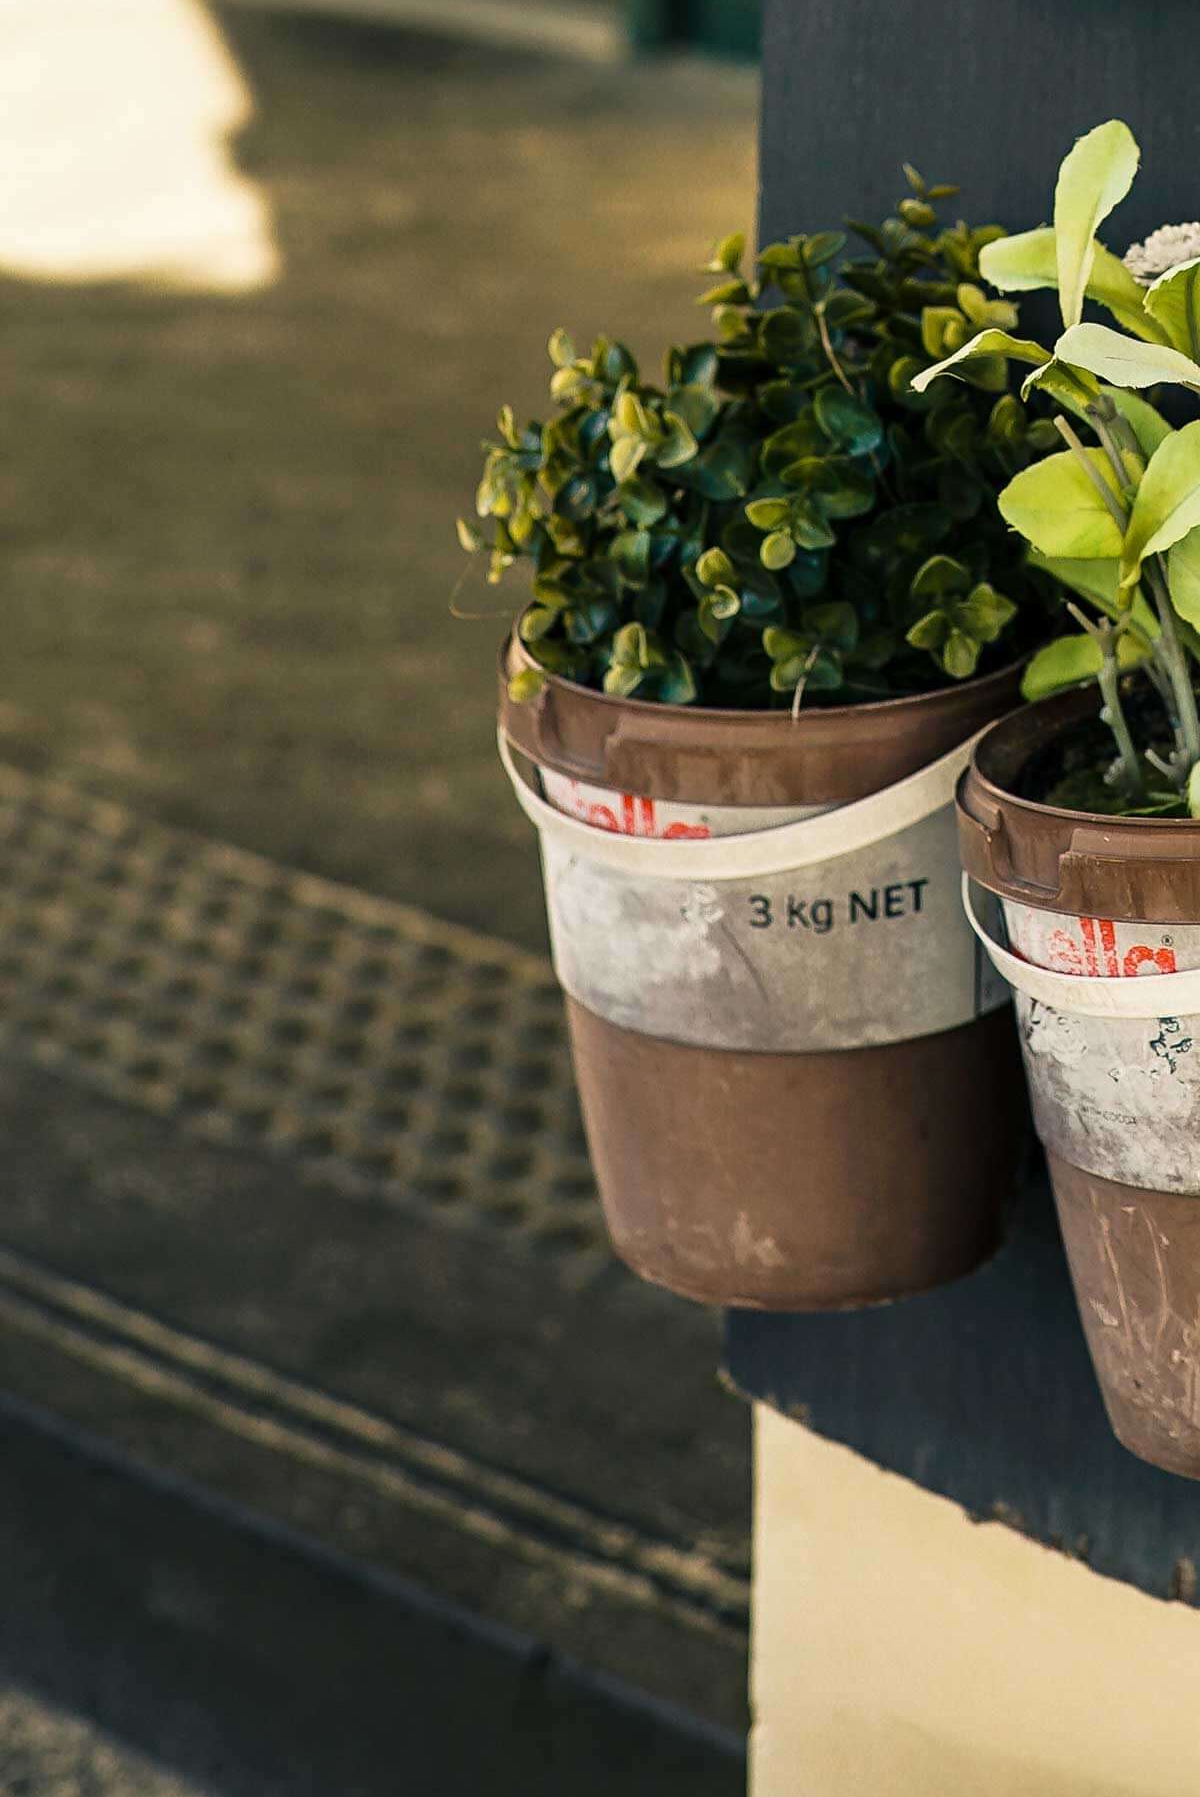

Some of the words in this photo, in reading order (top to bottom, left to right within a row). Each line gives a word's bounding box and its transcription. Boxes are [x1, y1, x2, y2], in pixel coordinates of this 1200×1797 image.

[748, 893, 774, 929] 3
[787, 893, 834, 935] kg
[849, 876, 929, 925] NET
